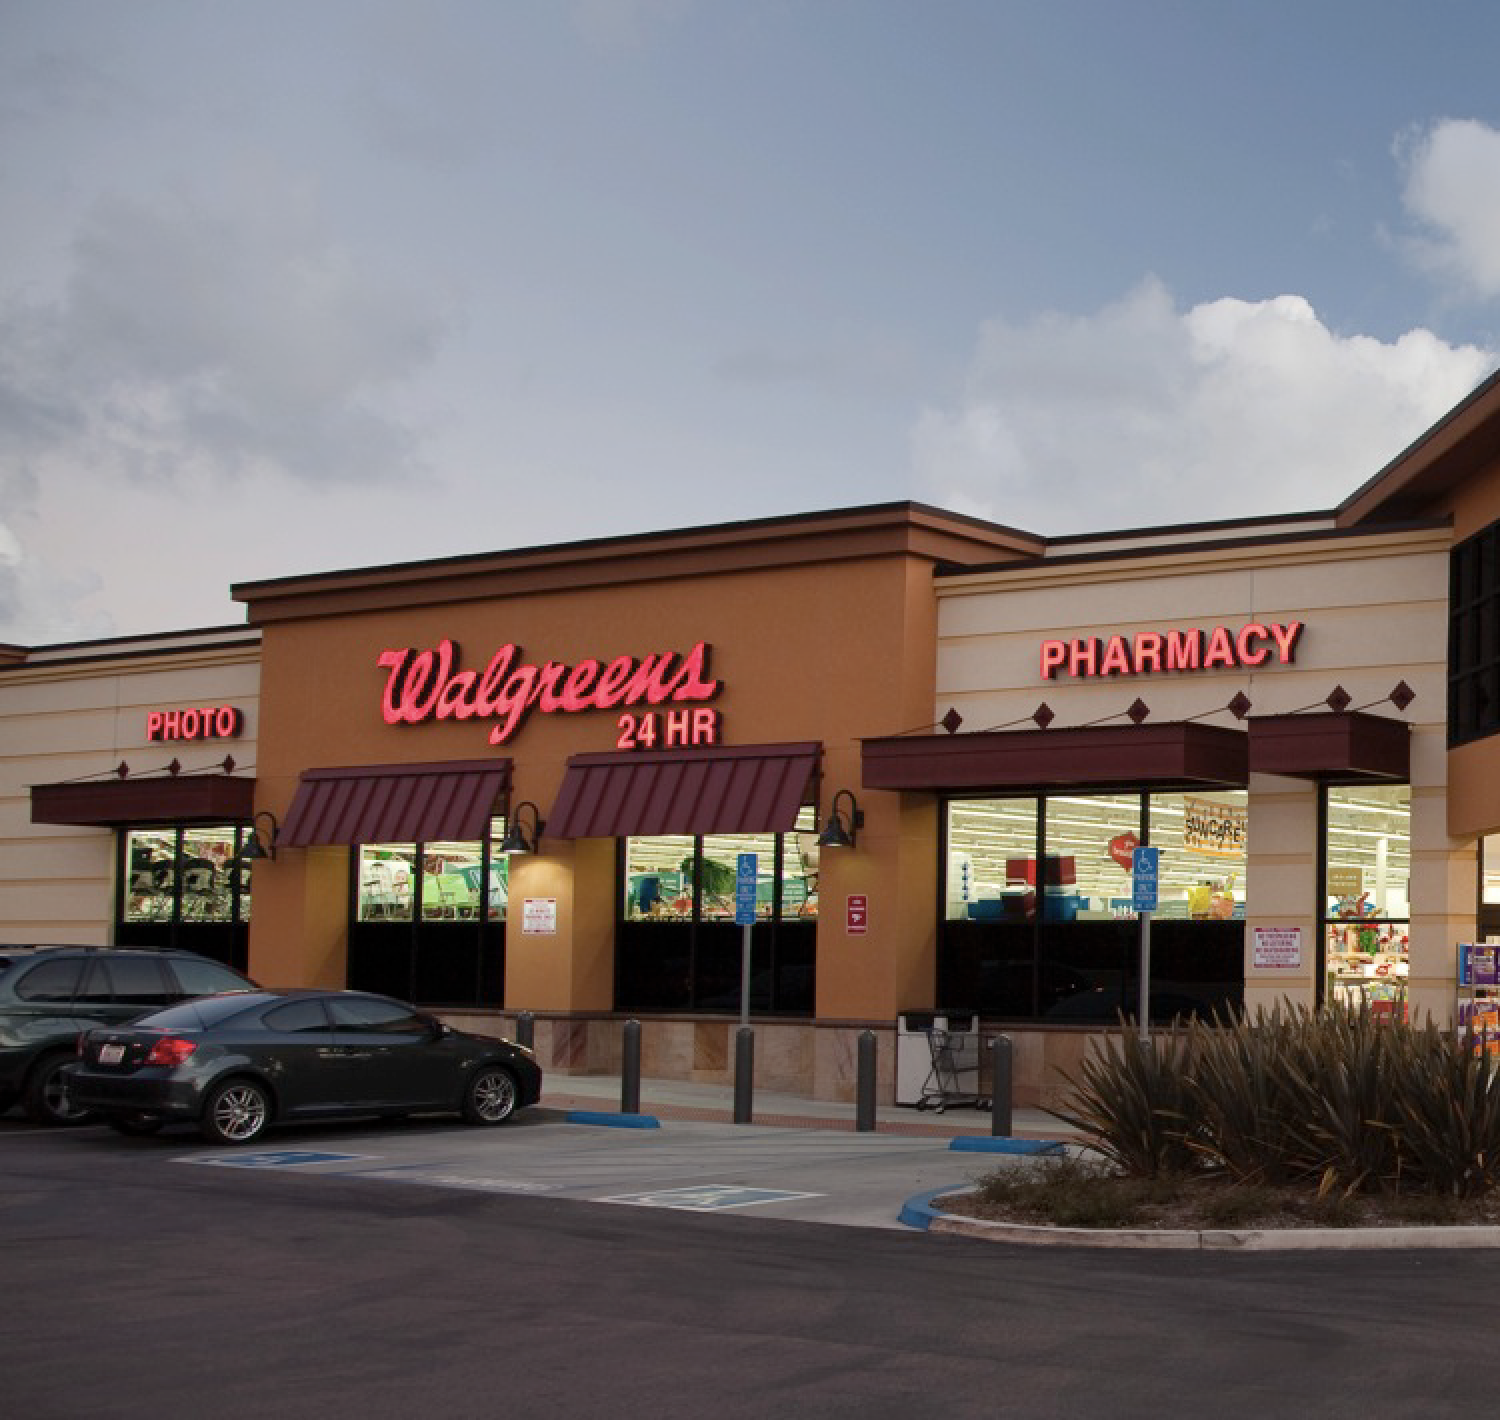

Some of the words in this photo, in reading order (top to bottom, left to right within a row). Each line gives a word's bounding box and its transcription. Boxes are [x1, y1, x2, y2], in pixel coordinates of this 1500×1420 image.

[1040, 621, 1302, 681] PHARMACY
[376, 639, 717, 745] Walgreens
[147, 704, 237, 741] PHOTO
[617, 712, 656, 749] 24
[667, 707, 716, 745] HR
